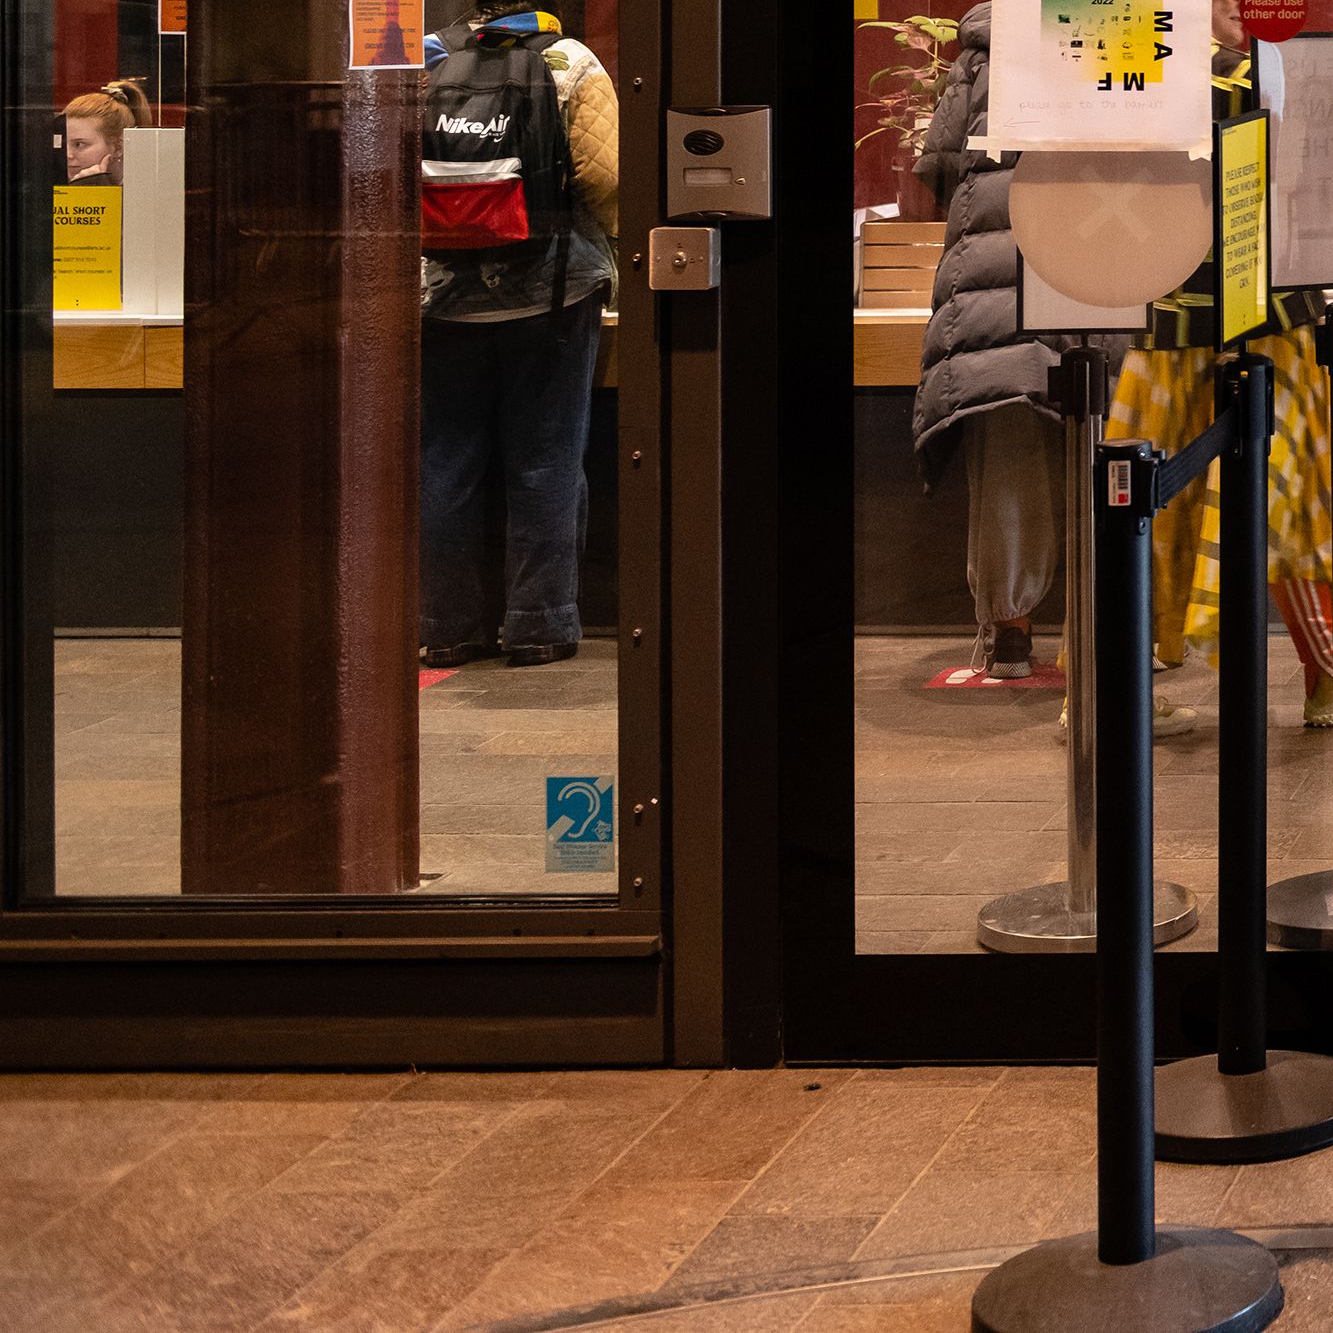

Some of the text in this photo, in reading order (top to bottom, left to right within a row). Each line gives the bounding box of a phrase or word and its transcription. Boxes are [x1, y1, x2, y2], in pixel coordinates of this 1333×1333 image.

[1243, 9, 1305, 20] other door
[73, 207, 106, 215] SHORT
[55, 217, 101, 225] COURSES
